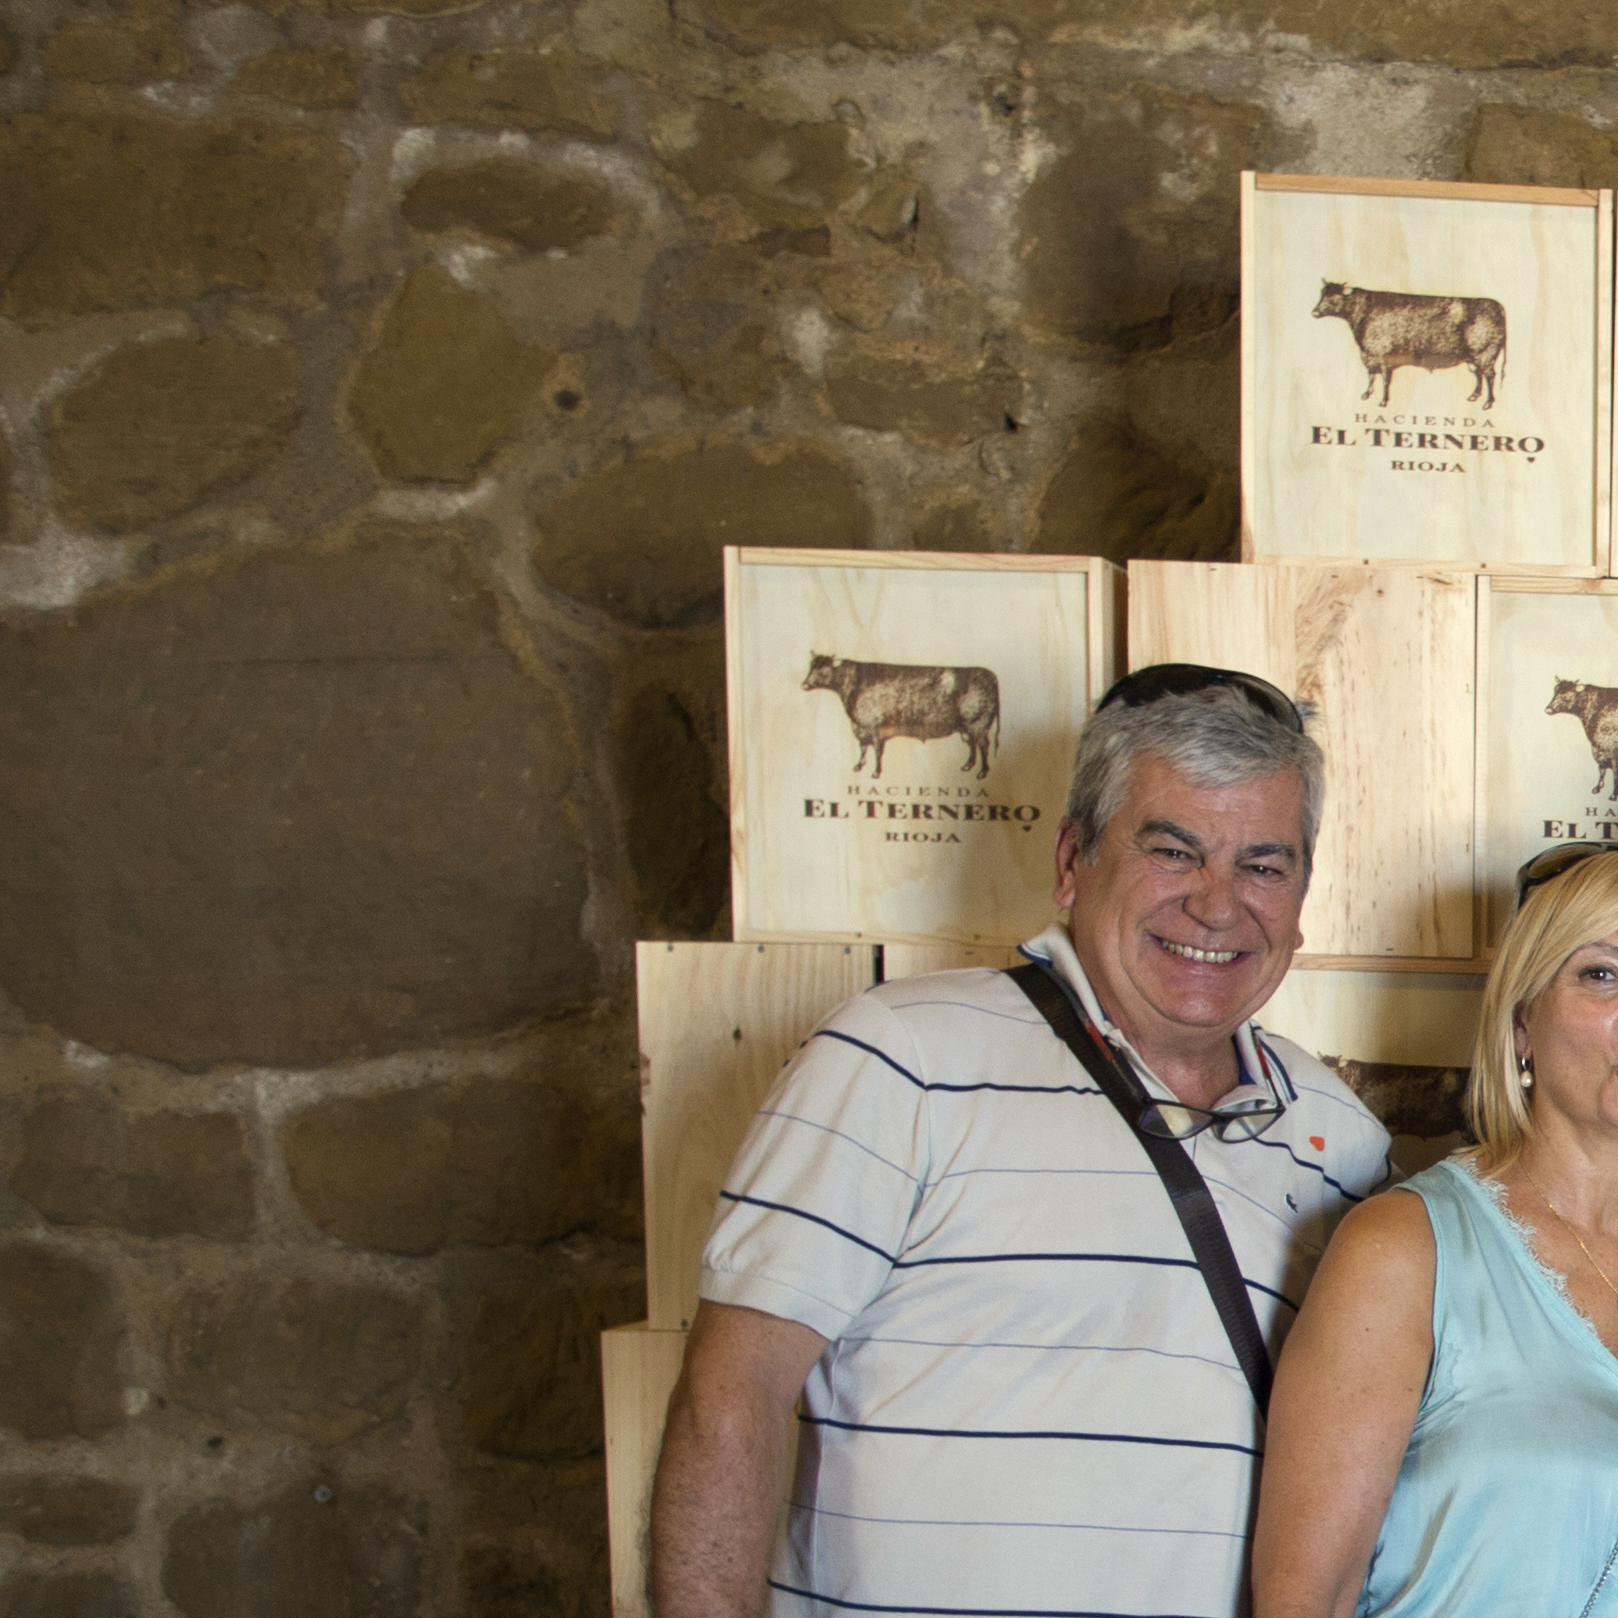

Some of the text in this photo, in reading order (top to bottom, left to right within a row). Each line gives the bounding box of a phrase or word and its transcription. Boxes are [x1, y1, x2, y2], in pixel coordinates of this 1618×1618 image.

[1354, 412, 1495, 429] HACIENDA
[1310, 425, 1545, 454] EL TERNERO
[1390, 459, 1467, 474] RIOJA
[846, 784, 991, 799] HACIENDA
[803, 797, 1041, 823] EL TERNERO
[885, 831, 962, 844] RIOJA
[1542, 819, 1588, 840] EL
